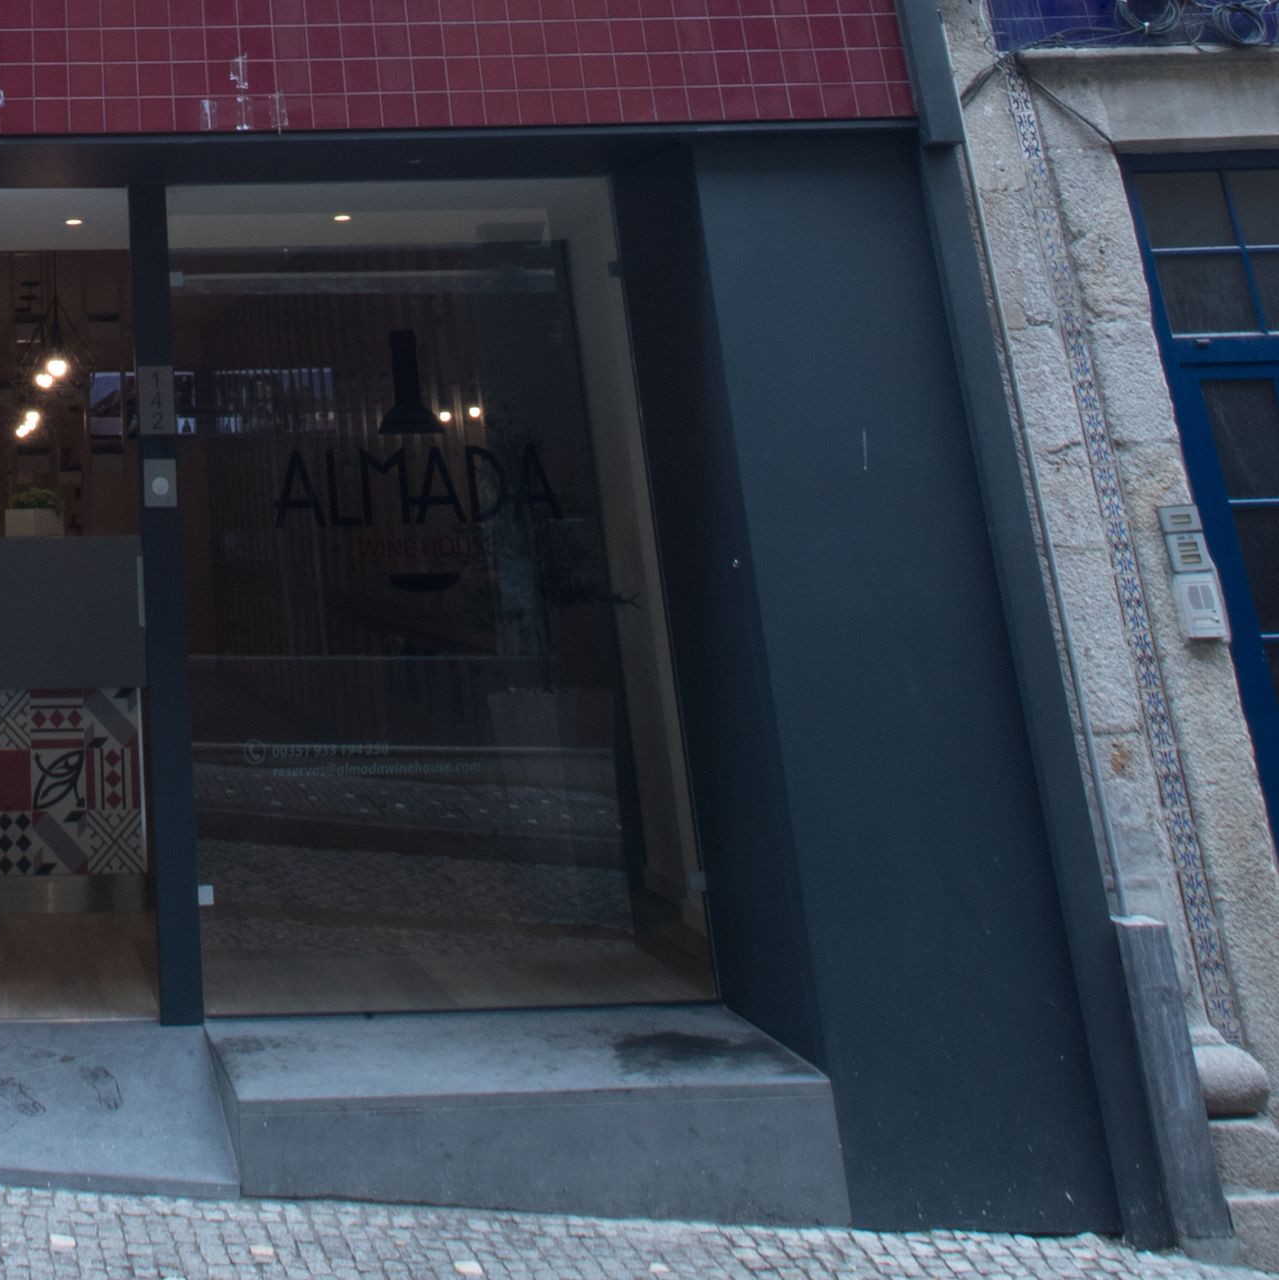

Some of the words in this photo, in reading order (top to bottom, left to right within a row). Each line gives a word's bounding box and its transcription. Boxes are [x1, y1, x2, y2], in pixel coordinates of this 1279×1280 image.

[151, 372, 164, 430] 142
[275, 444, 563, 528] ALMADA
[360, 536, 416, 560] WINE
[422, 535, 497, 559] HOUSE
[271, 761, 482, 778] reservas@almadawinehouse.com
